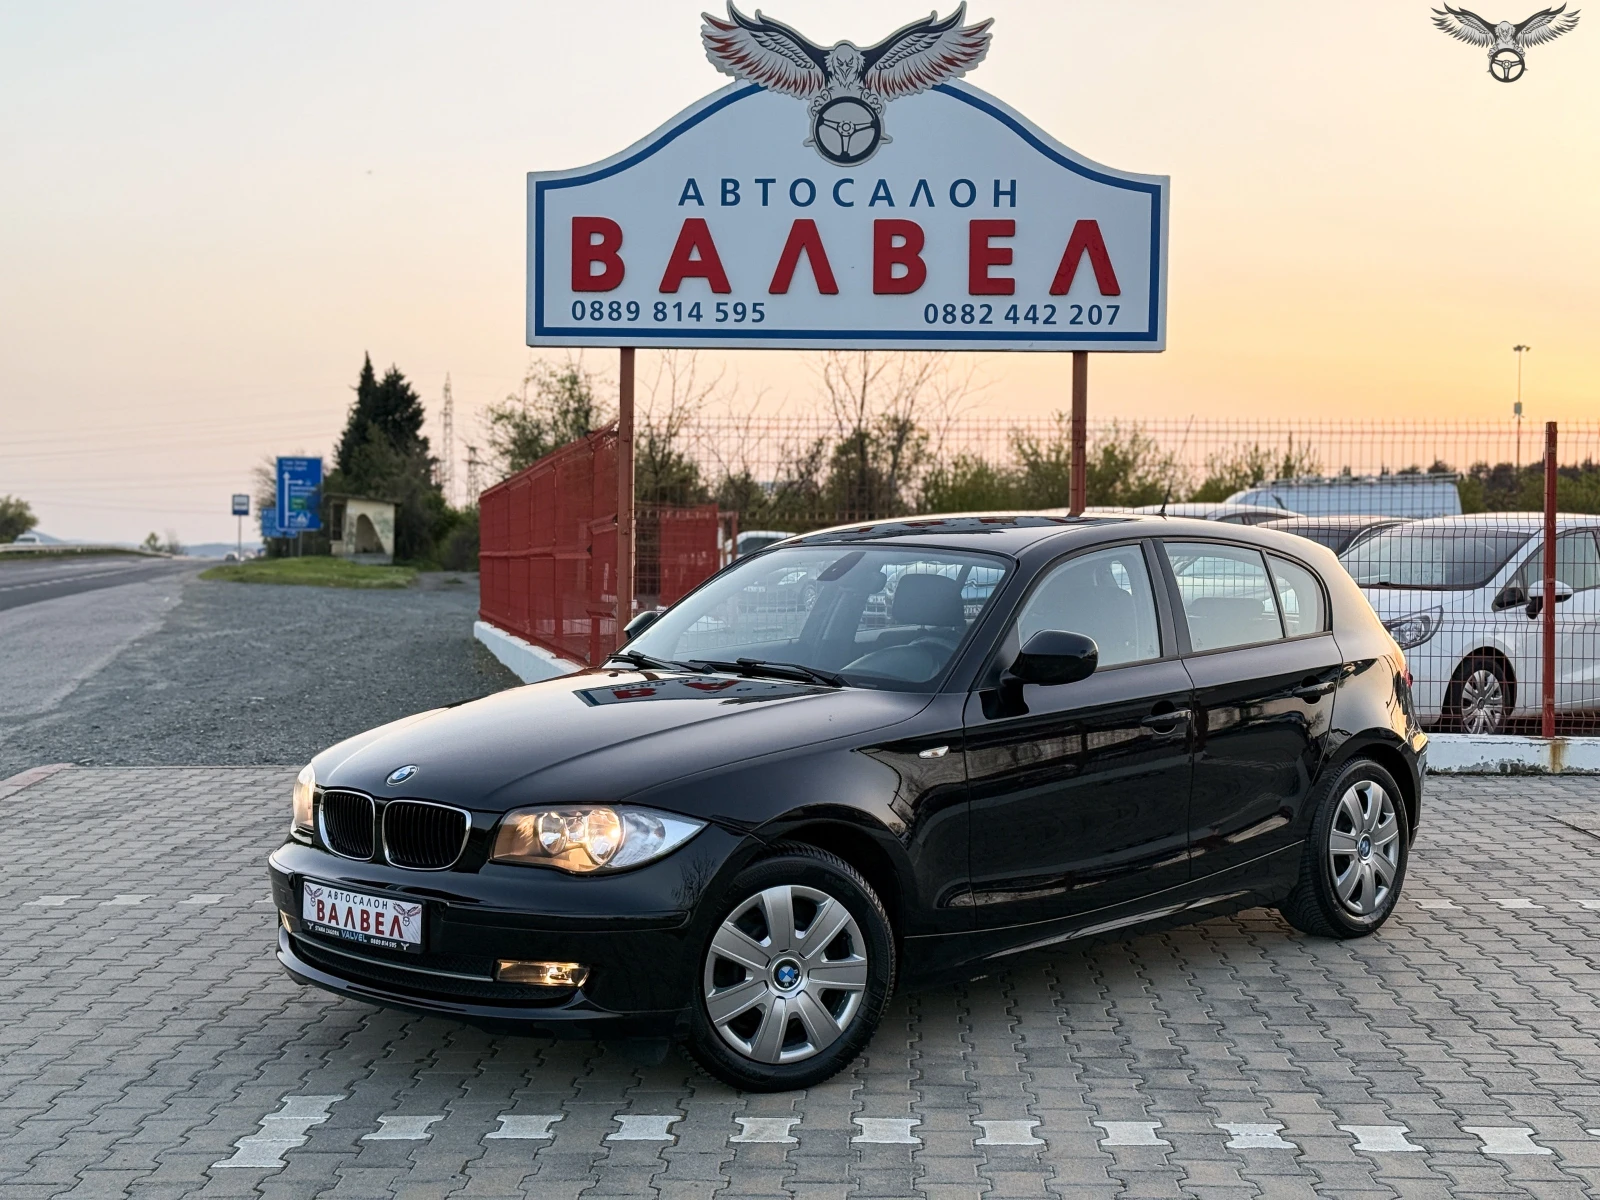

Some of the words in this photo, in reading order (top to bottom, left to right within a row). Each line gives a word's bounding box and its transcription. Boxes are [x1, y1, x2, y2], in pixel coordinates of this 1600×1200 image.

[677, 177, 1017, 208] АВТОСАЛОН
[571, 217, 1121, 296] ВАЛВЕЛ
[571, 299, 641, 322] 0889
[652, 301, 704, 323] 814
[715, 301, 766, 324] 595
[923, 303, 994, 325] 0882
[1004, 303, 1057, 325] 442
[1068, 304, 1121, 326] 207
[327, 890, 388, 910] АВТОСАЛОН
[317, 899, 404, 939] ВАЛВЕЛ
[341, 930, 367, 943] VALVEL
